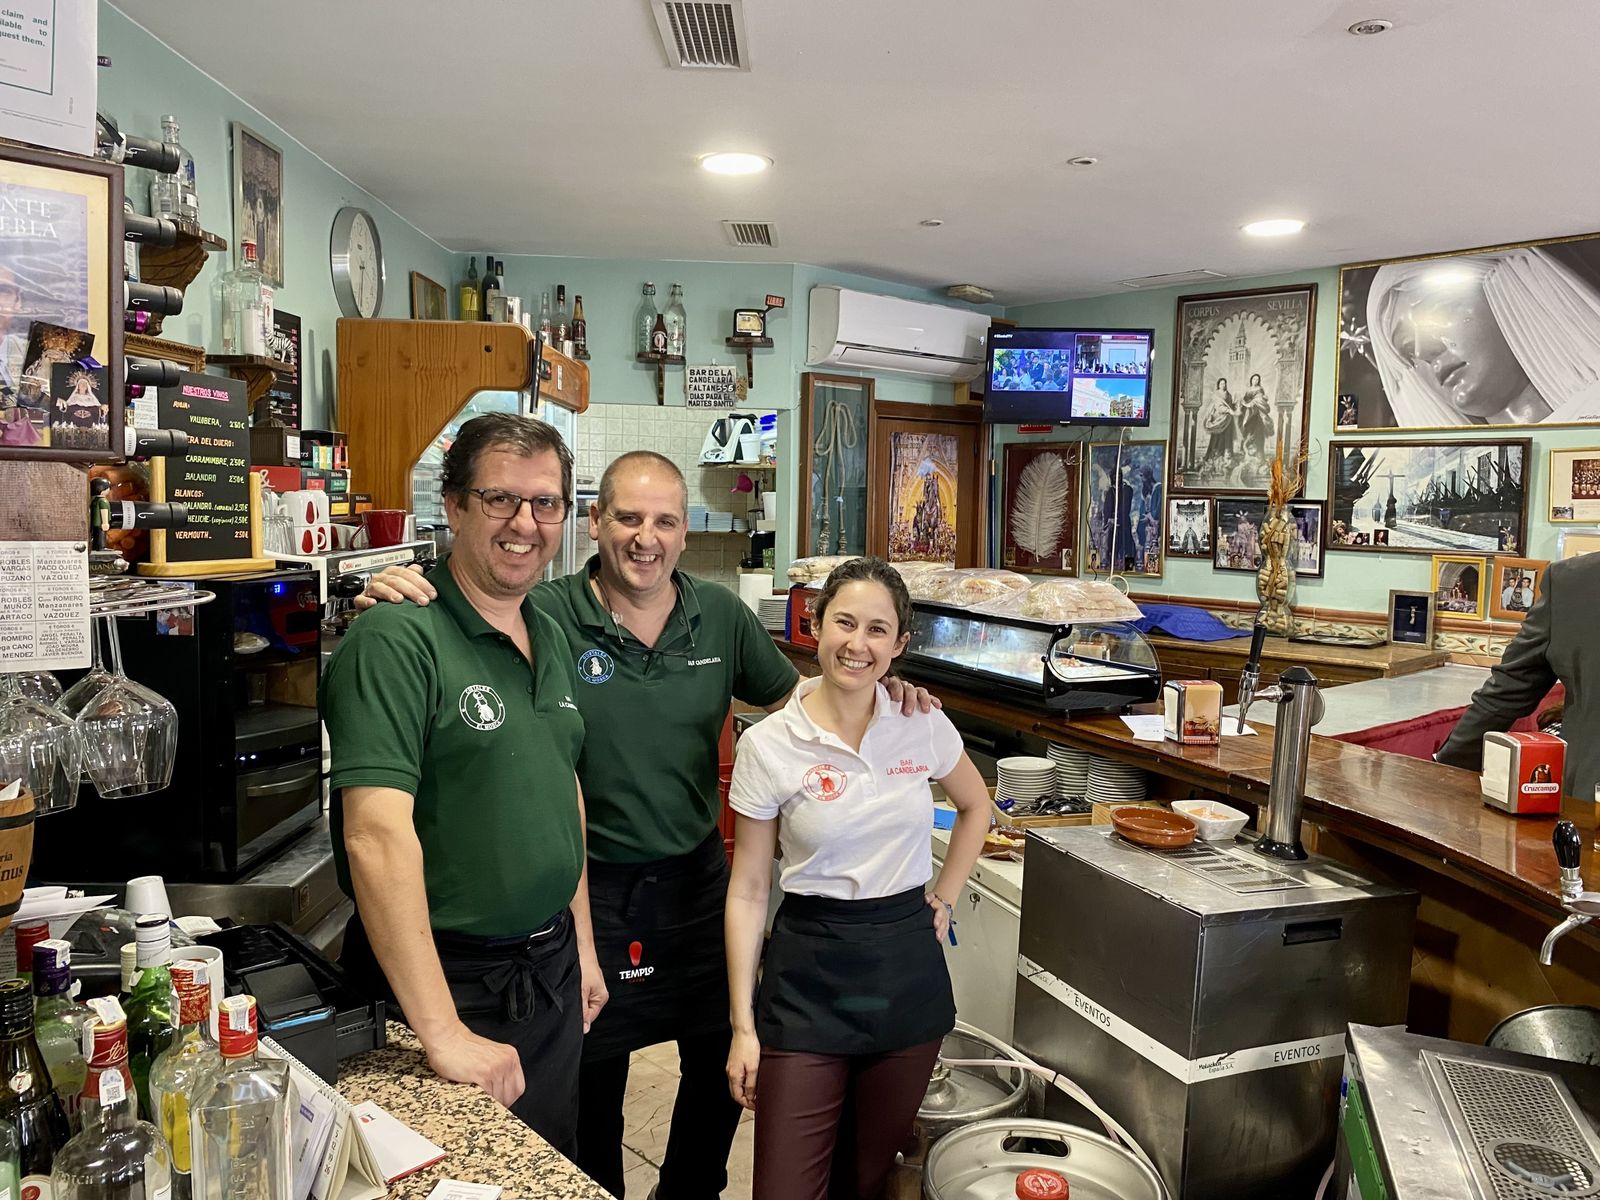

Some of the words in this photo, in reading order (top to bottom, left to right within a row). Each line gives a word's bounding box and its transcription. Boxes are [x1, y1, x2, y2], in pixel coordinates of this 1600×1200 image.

[1, 9, 24, 20] claim
[32, 17, 48, 26] and
[39, 29, 47, 37] to
[21, 35, 46, 47] them.
[1188, 306, 1220, 318] CORPUS
[1267, 299, 1303, 311] SEVILLA
[689, 369, 707, 377] BAR
[708, 369, 720, 377] DE
[720, 369, 733, 377] LA
[182, 384, 211, 398] NUESTROS
[213, 389, 230, 400] VINOS
[688, 384, 715, 392] FALTAN
[705, 393, 722, 401] PARA
[200, 438, 212, 446] DEL
[1, 634, 33, 642] ROMERO
[886, 768, 894, 776] LA
[895, 764, 929, 775] CANDELARIA
[1524, 784, 1557, 792] Cruzcampo
[619, 966, 654, 980] TEMPLO
[1074, 993, 1111, 1027] EVENTOS
[1273, 1044, 1320, 1063] EVENTOS
